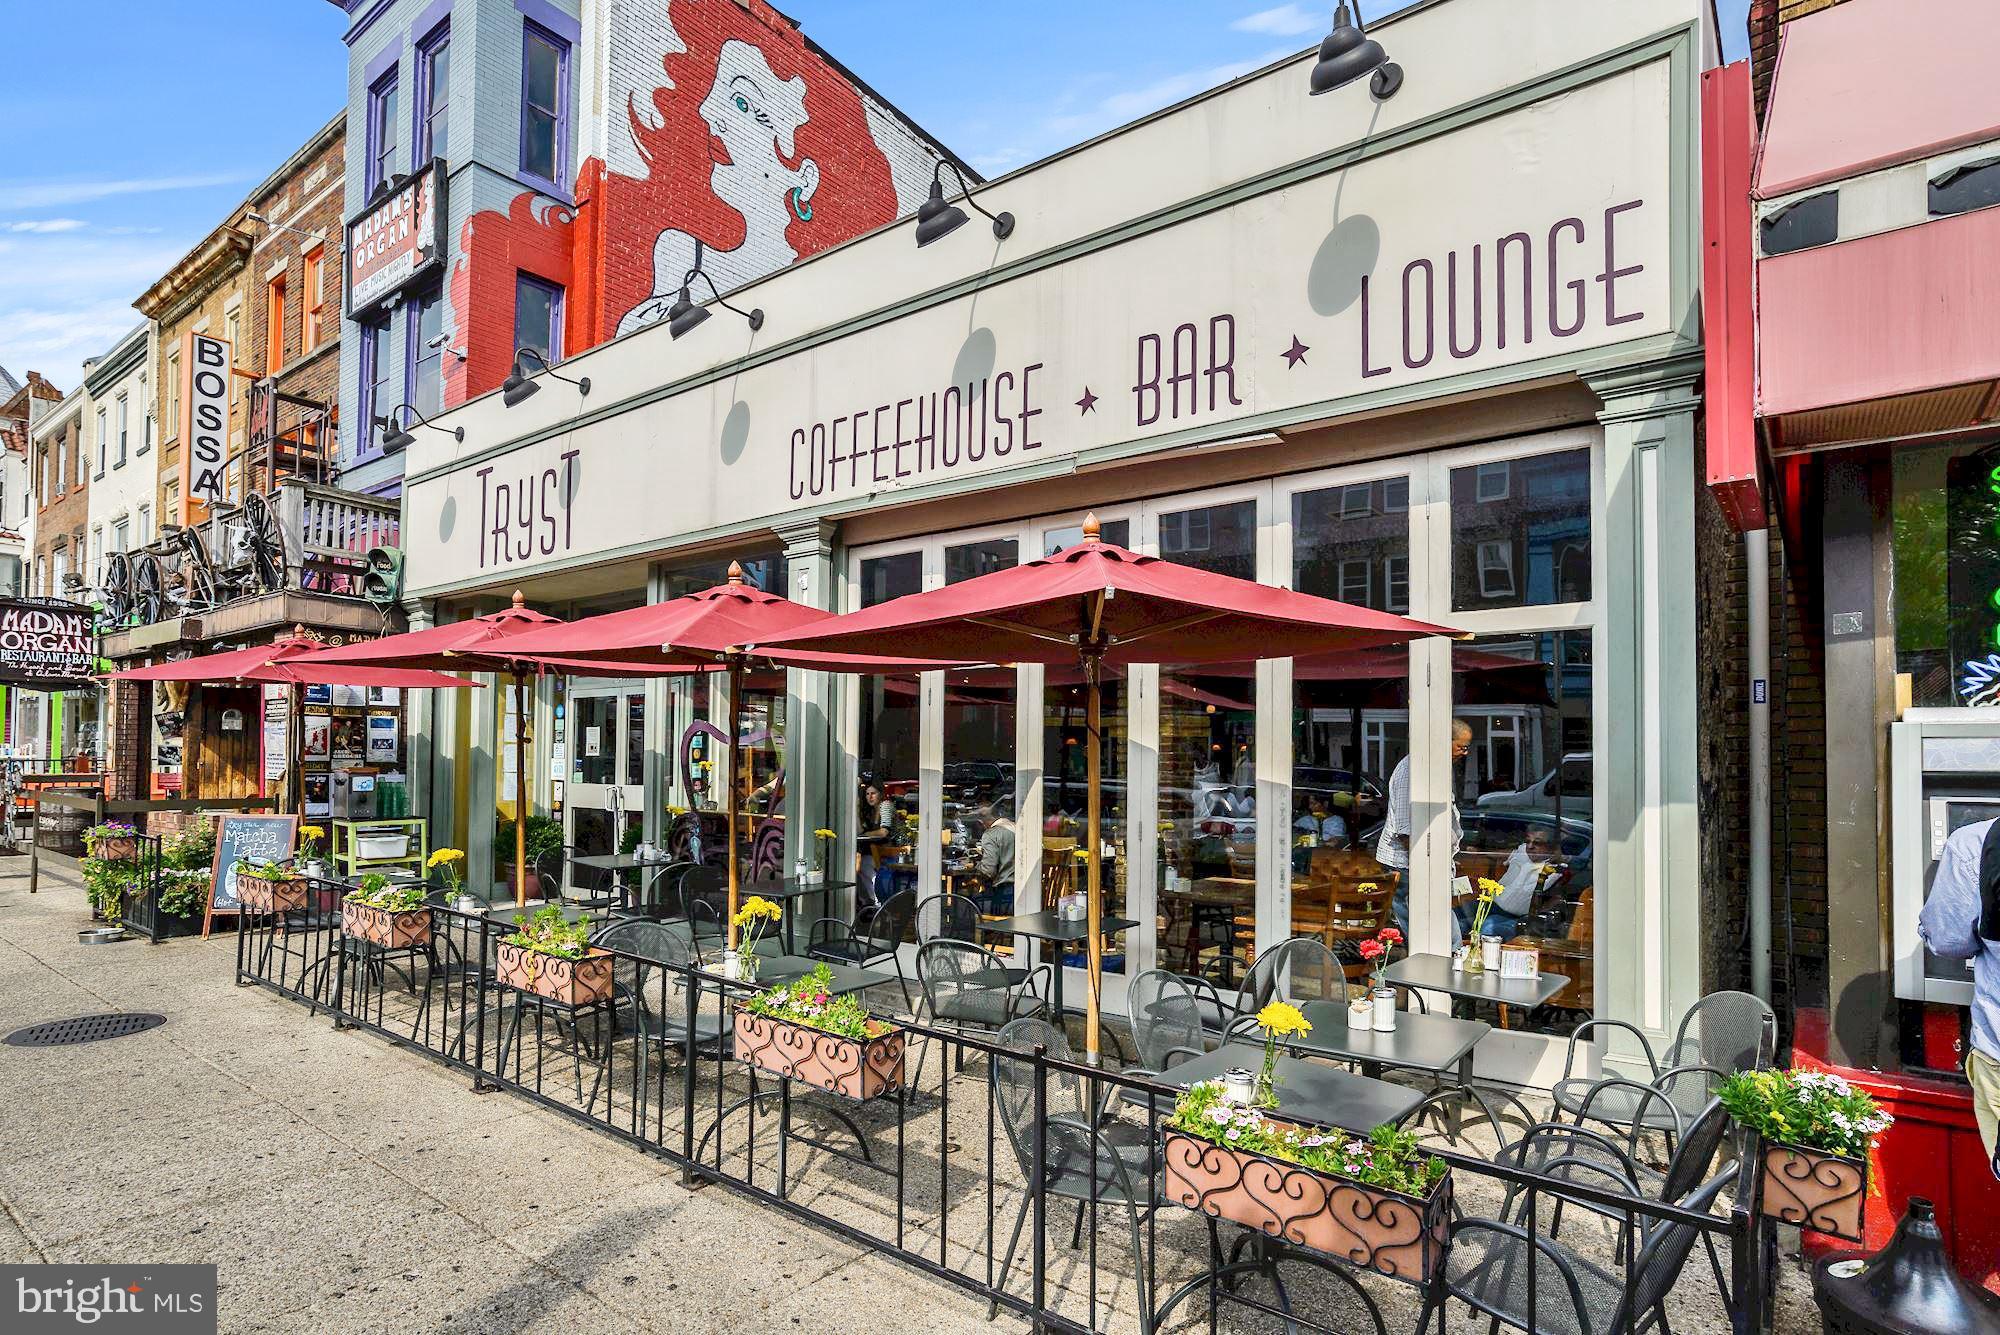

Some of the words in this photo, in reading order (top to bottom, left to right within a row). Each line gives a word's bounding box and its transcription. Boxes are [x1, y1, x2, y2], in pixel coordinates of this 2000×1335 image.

[356, 214, 409, 269] ORGAN
[476, 449, 580, 568] TRYST
[789, 362, 1044, 500] COFFEEHOUSE
[1132, 313, 1243, 427] BAR
[1361, 199, 1645, 379] LOUNGE
[193, 337, 226, 496] BOSSA
[23, 597, 46, 606] SINCE
[1, 608, 93, 637] MADAM'S
[0, 631, 93, 654] ORGAN
[0, 649, 66, 664] RESTAURANT
[72, 653, 93, 666] BAR
[224, 828, 279, 844] Matcha
[233, 843, 287, 859] Latte!
